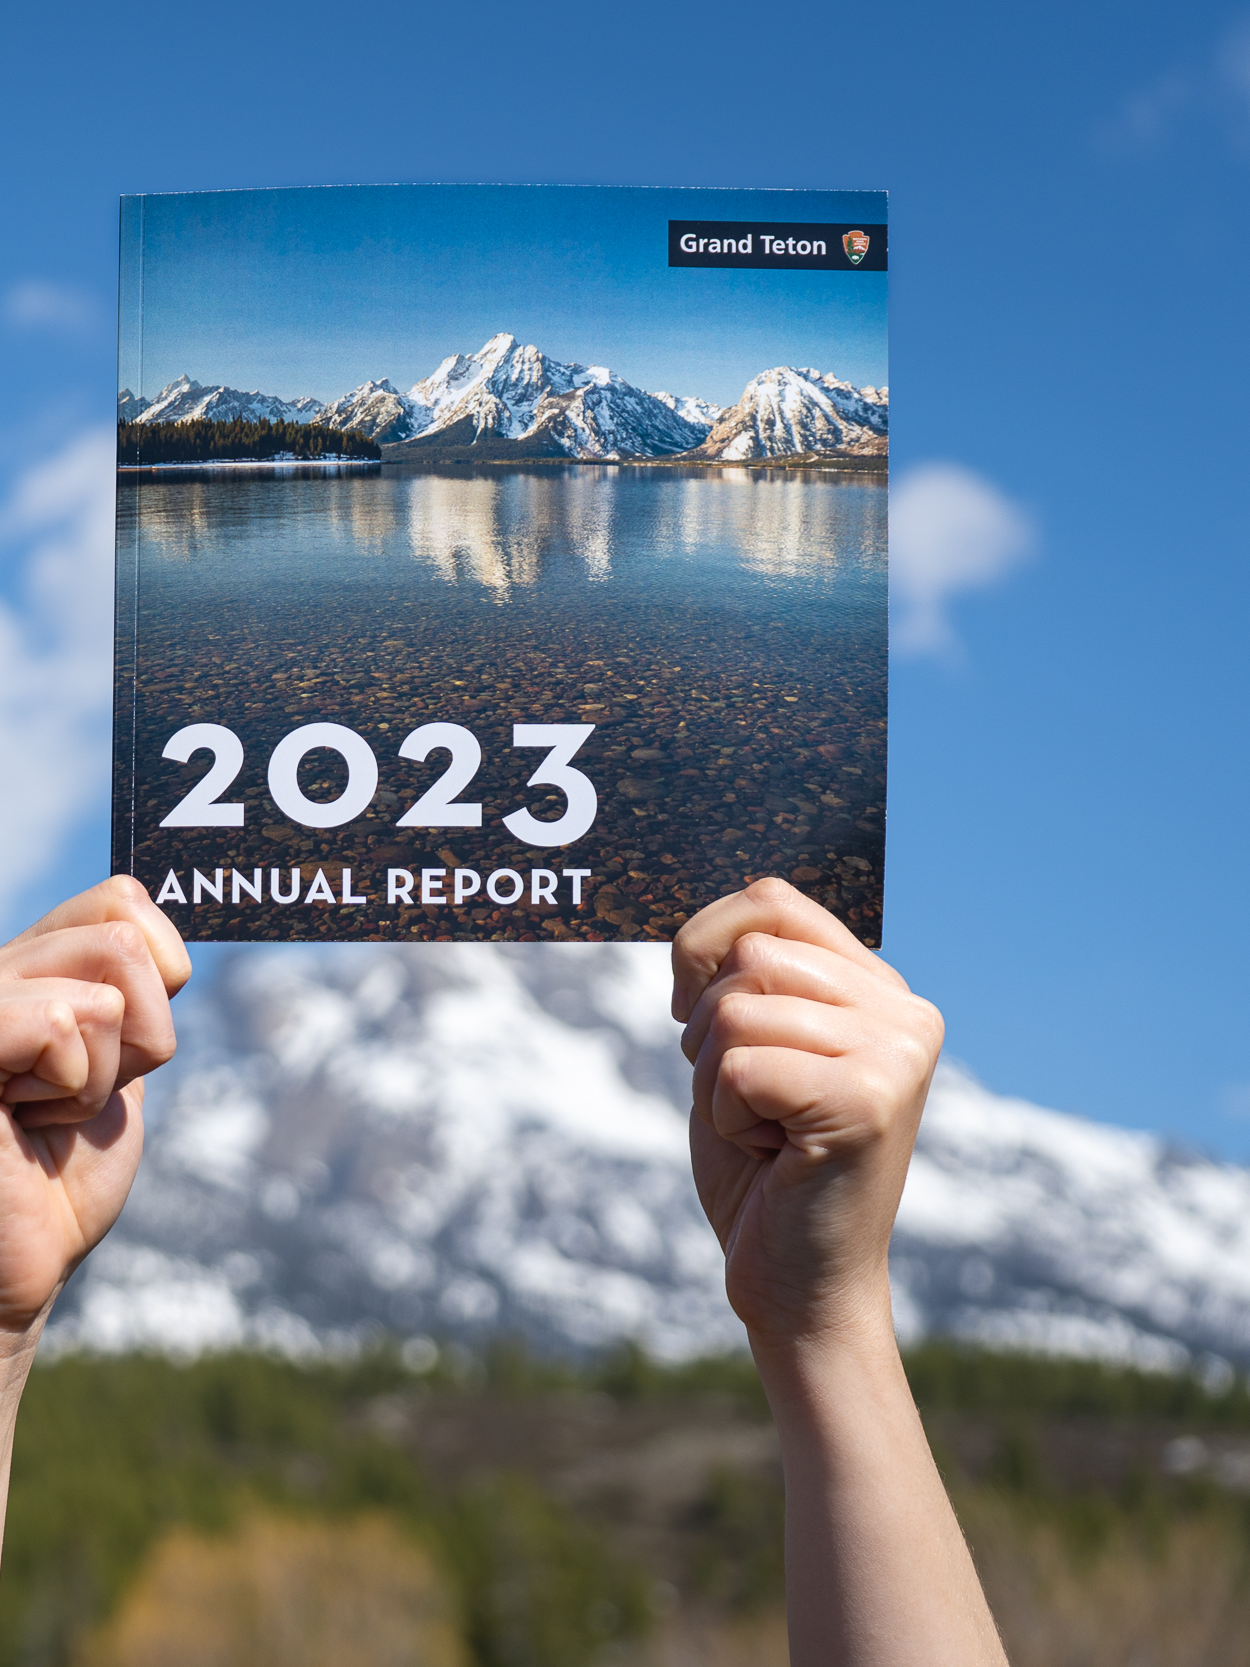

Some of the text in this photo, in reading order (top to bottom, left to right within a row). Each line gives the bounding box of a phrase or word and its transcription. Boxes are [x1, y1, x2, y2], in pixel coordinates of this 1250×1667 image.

[679, 233, 753, 254] Grand
[760, 235, 827, 256] Teton
[159, 722, 598, 847] 2023
[155, 867, 592, 905] ANNUAL REPORT
